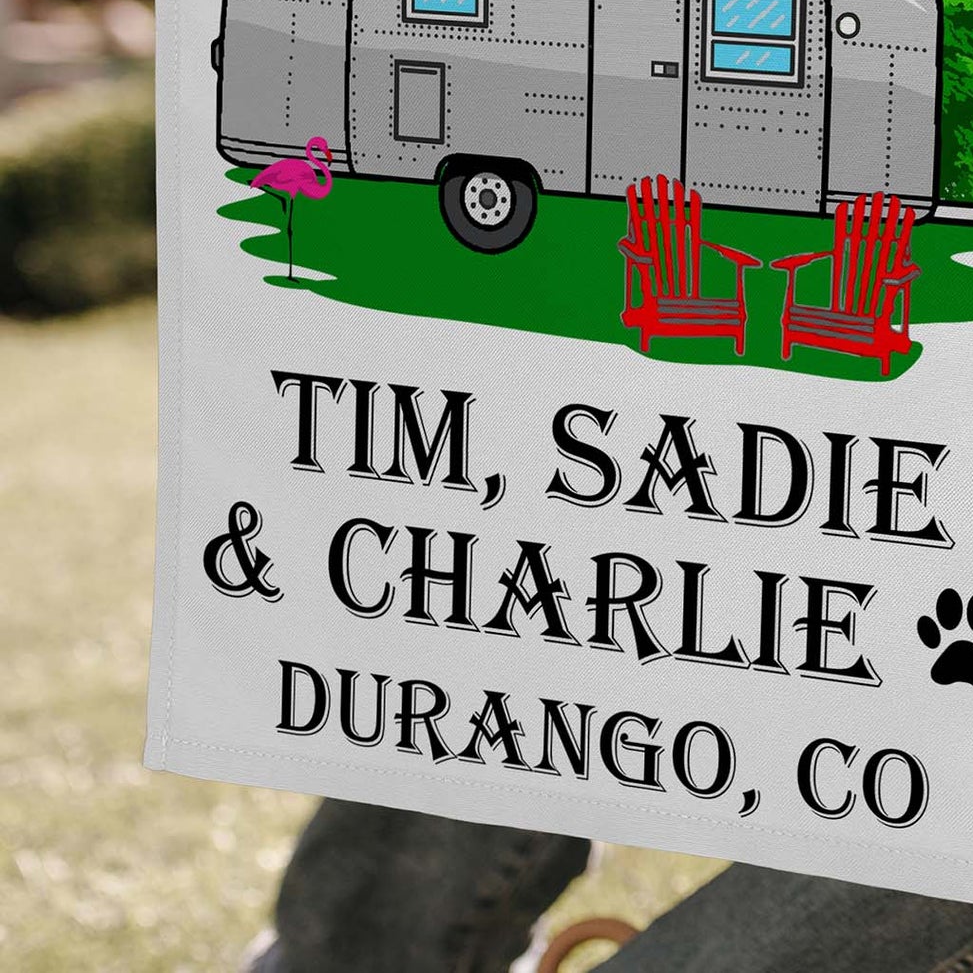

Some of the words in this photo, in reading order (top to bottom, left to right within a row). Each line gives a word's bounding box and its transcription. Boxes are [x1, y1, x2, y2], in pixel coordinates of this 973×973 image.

[270, 369, 507, 511] TIM,
[544, 403, 956, 550] SADIE
[203, 501, 285, 604] &
[328, 517, 884, 688] CHARLIE
[275, 659, 761, 818] DURANGO,
[797, 737, 930, 829] CO
